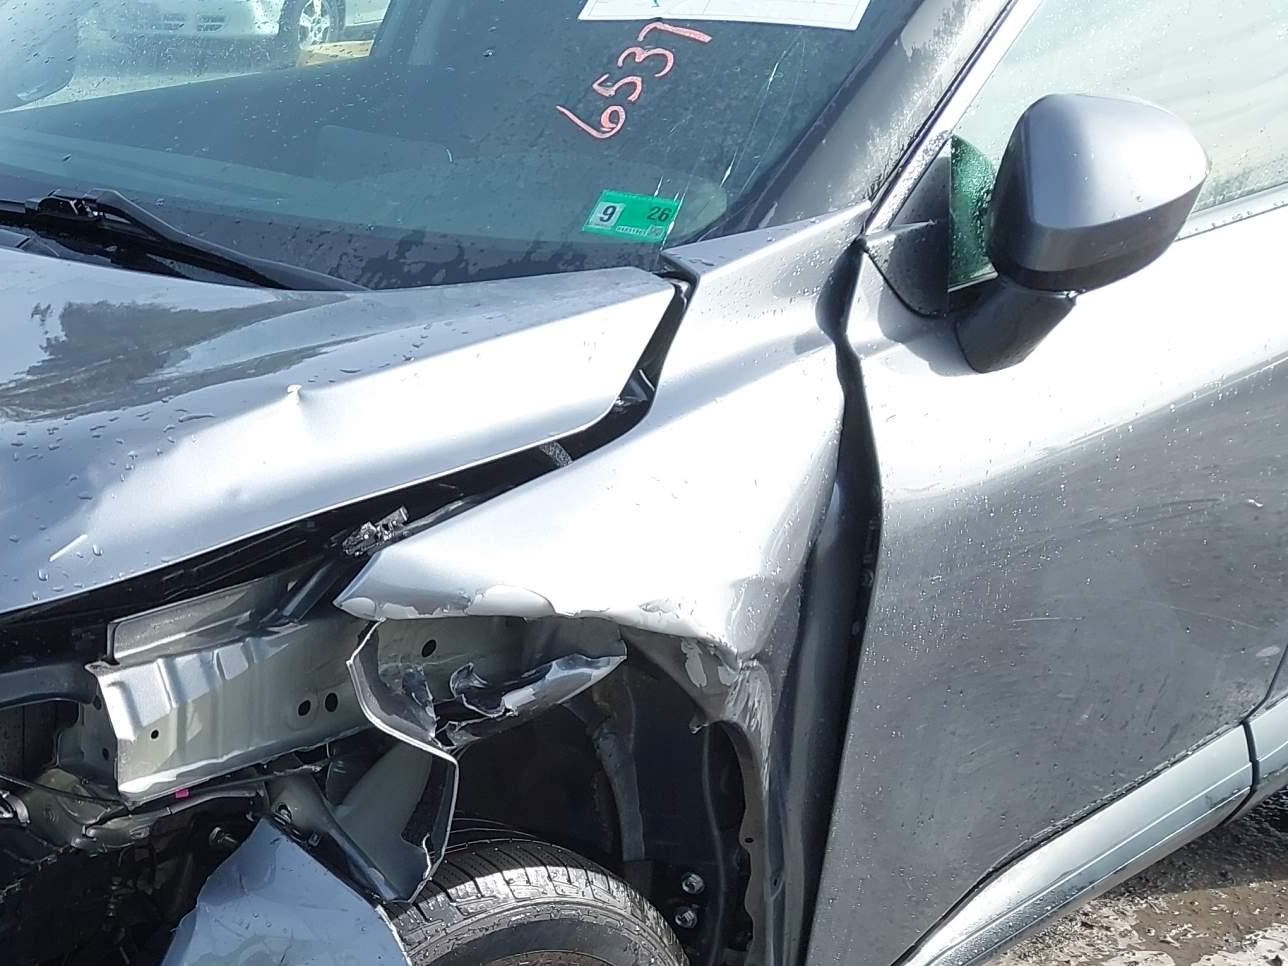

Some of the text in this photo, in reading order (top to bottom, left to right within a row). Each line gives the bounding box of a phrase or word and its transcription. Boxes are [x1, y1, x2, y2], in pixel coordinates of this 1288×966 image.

[556, 21, 712, 140] 6537
[599, 204, 673, 223] 9 26
